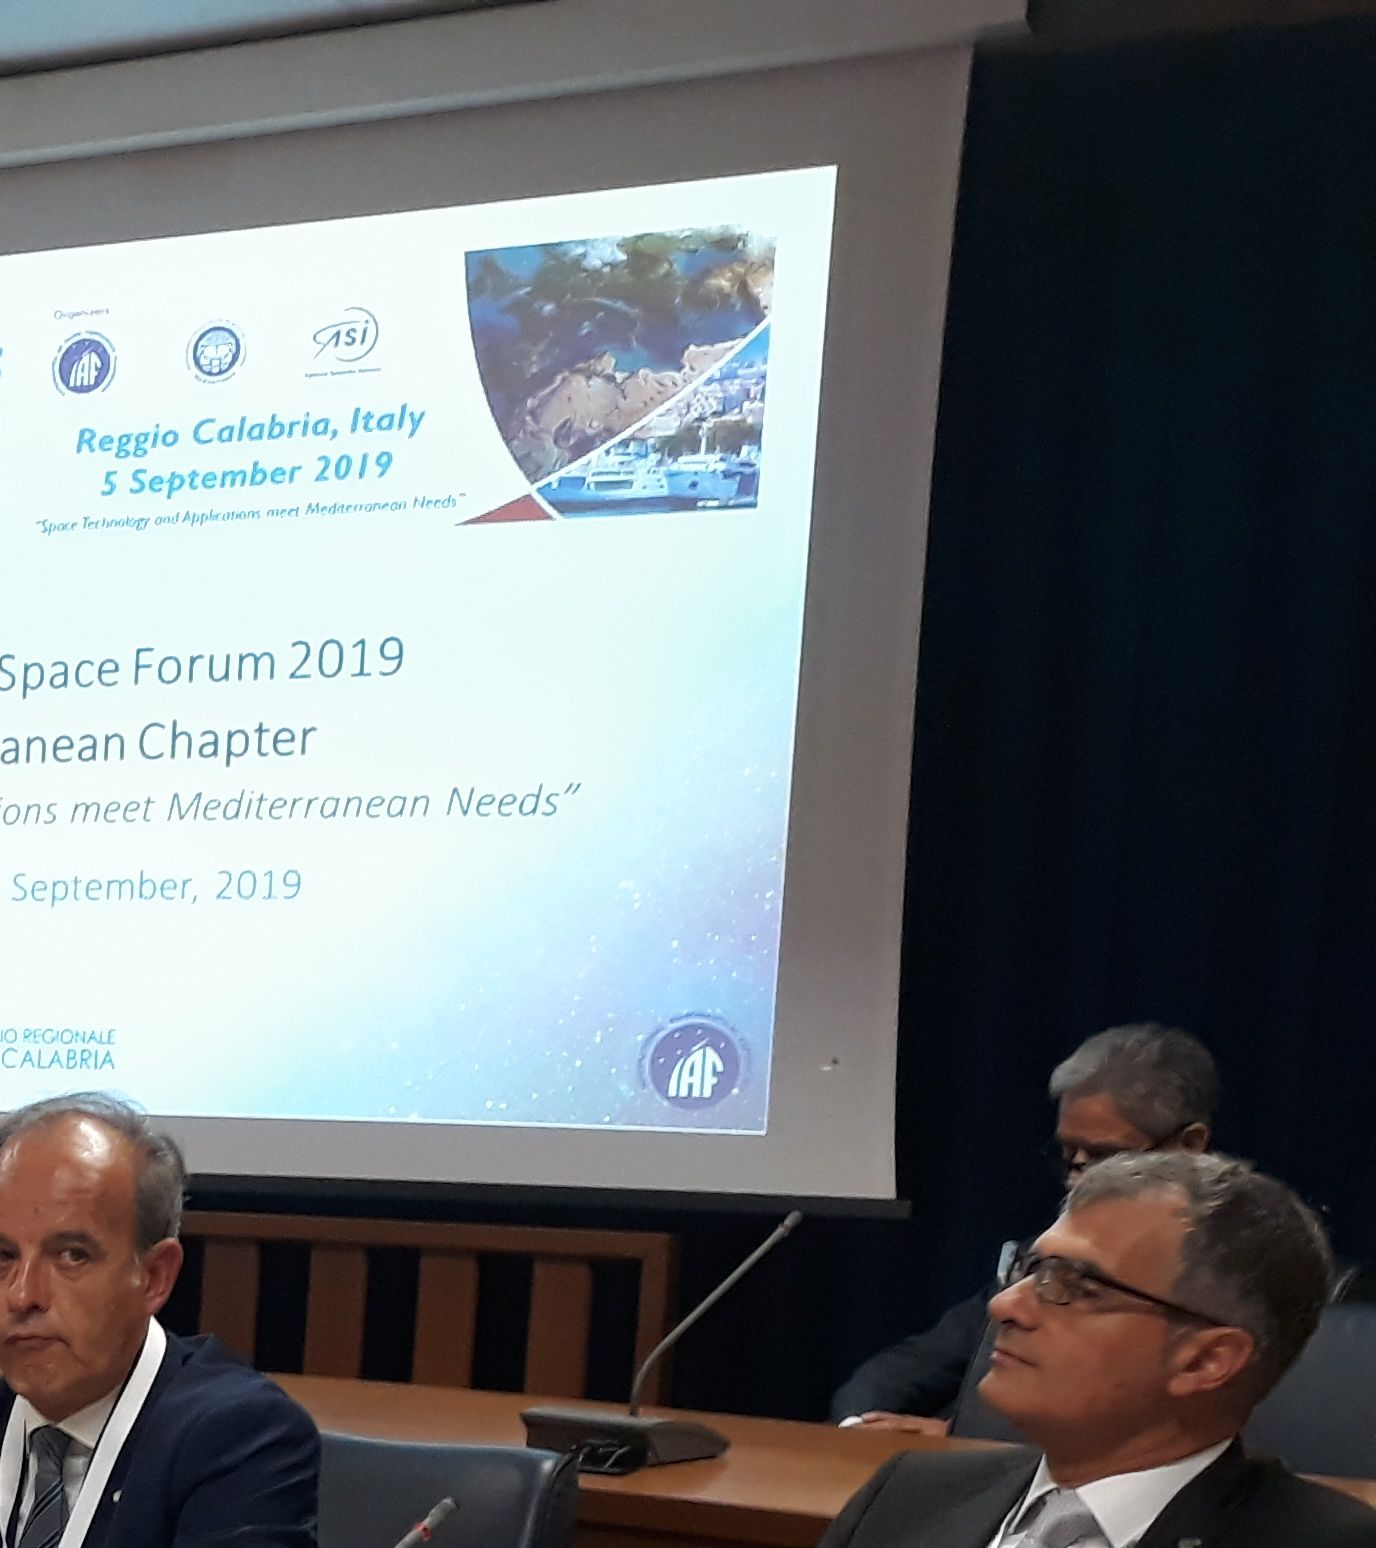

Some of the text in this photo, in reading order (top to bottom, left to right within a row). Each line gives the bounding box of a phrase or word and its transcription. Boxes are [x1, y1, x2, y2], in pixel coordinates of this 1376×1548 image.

[76, 403, 426, 460] Reggio Calabria, Italy
[100, 451, 394, 499] 5 September 2019
[133, 646, 276, 686] Forum
[288, 636, 404, 679] 2019
[138, 719, 318, 767] Chapter
[70, 794, 155, 824] meet
[166, 788, 430, 822] Mediterranean
[12, 869, 199, 909] September,
[215, 868, 302, 900] 2019
[1, 1047, 115, 1070] CALABRIA
[23, 1028, 116, 1045] REGIONALE
[667, 1044, 724, 1098] IAF
